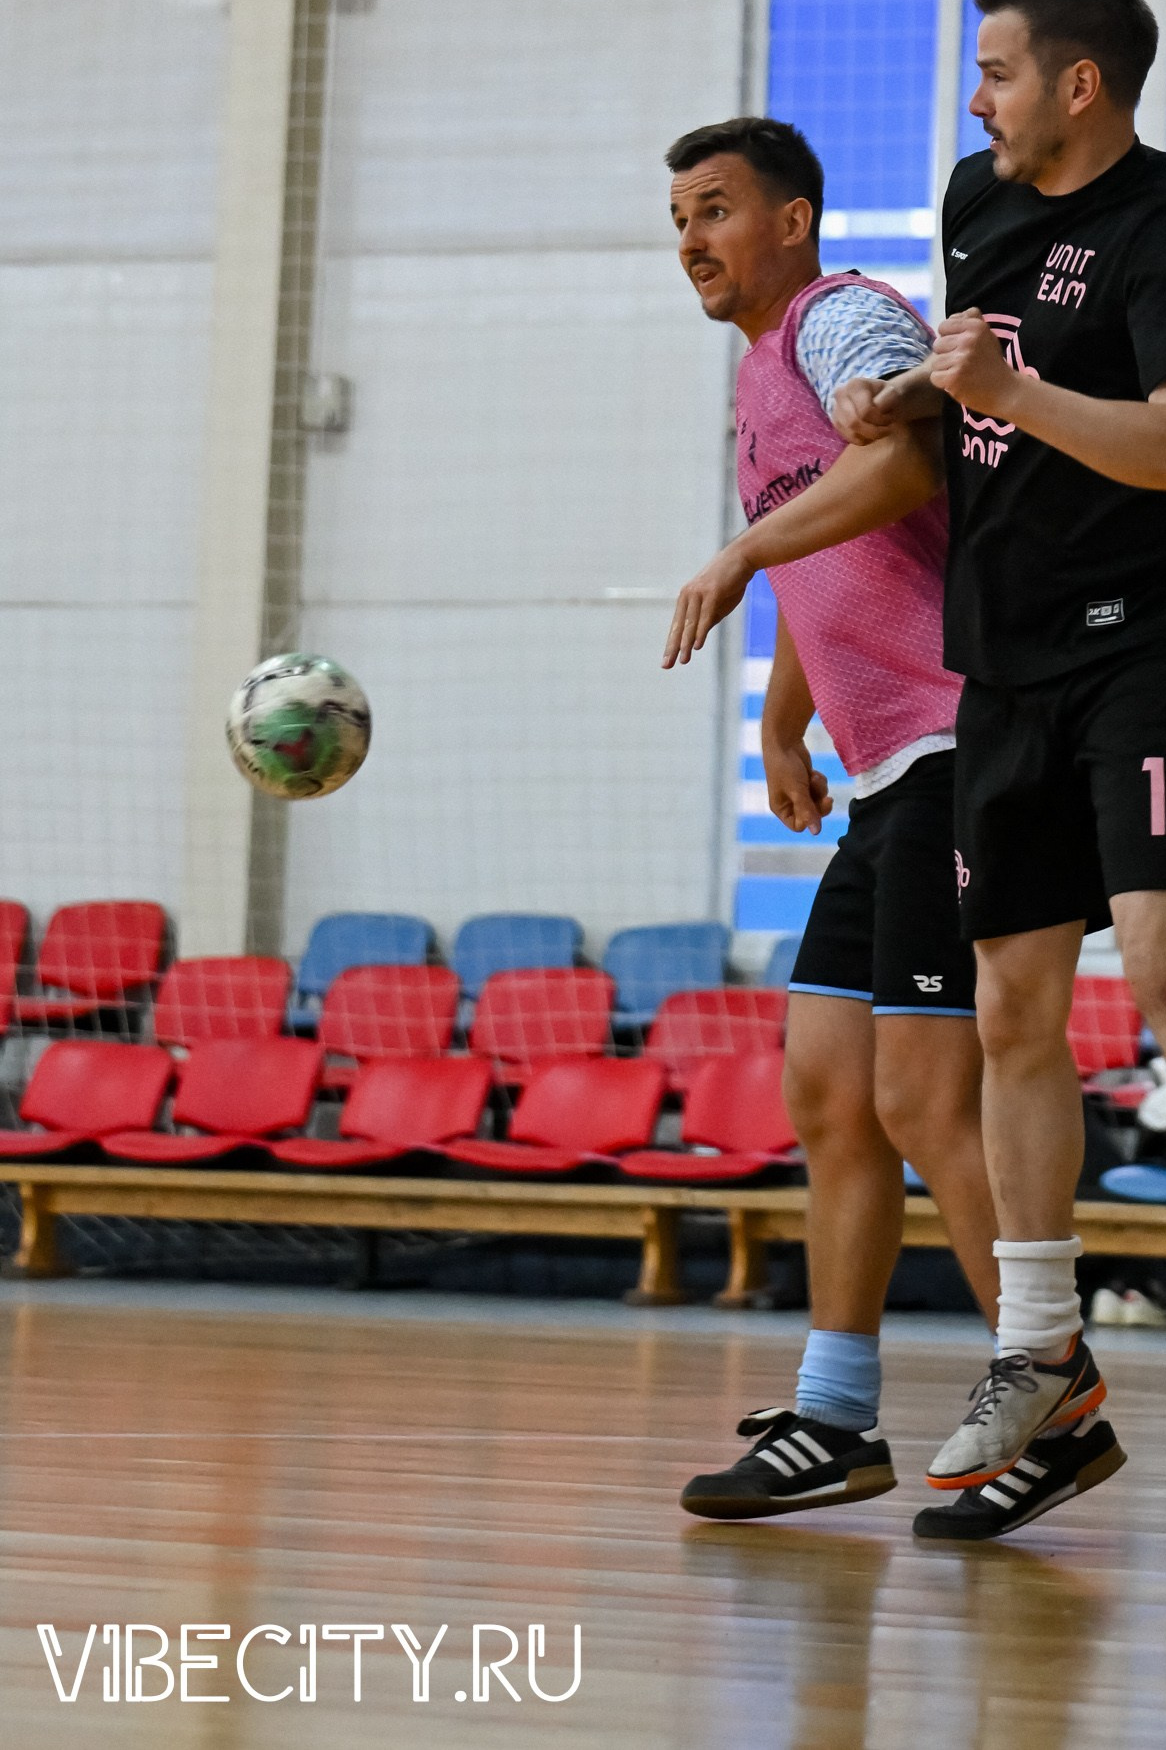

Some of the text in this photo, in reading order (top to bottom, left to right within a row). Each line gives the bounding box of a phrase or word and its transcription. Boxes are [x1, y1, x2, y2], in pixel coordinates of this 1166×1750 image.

[1045, 241, 1096, 276] UNIT
[1037, 272, 1087, 309] EAM
[743, 457, 824, 526] ЦЕНТРИК
